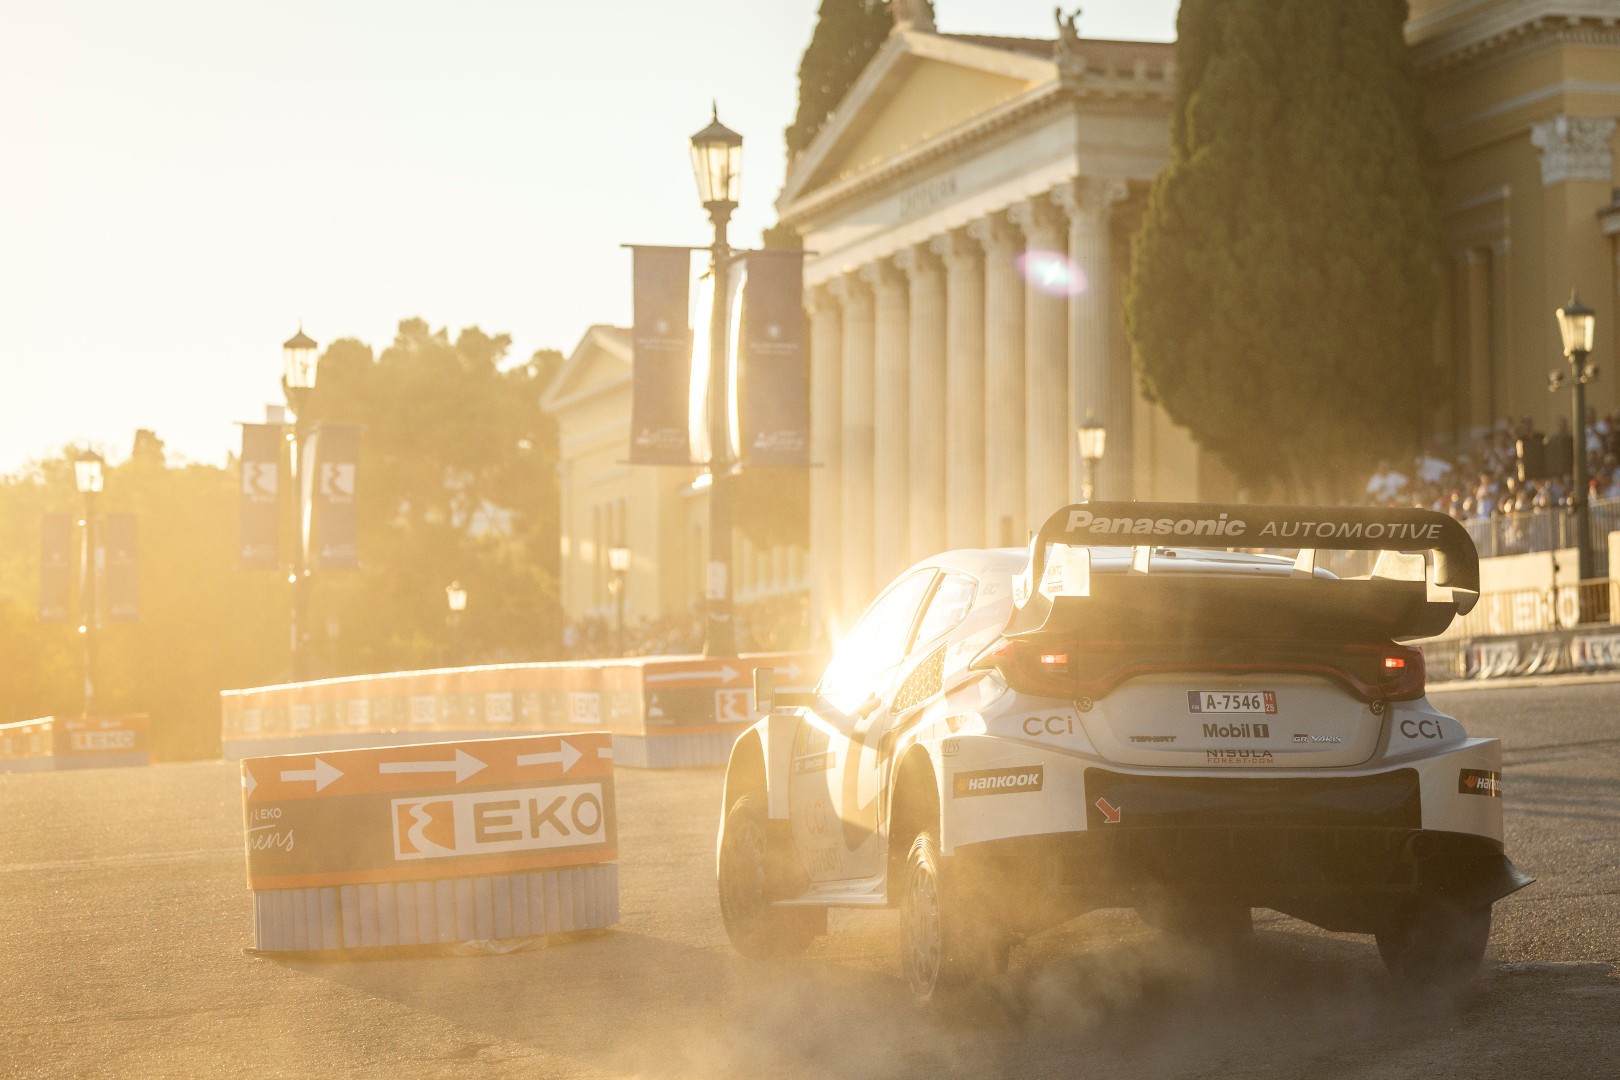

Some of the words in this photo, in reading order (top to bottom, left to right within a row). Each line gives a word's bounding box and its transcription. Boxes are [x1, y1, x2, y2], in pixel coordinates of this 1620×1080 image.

[1065, 510, 1246, 536] Panasonic
[1258, 521, 1442, 539] AUTOMOTIVE
[1207, 695, 1260, 709] A-7546
[1264, 693, 1273, 701] 11
[1265, 704, 1275, 712] 25
[1202, 724, 1250, 738] Mobil
[1310, 735, 1342, 743] YARIS
[1206, 749, 1273, 757] NISULA
[260, 808, 282, 819] EKO
[473, 792, 602, 843] EKO
